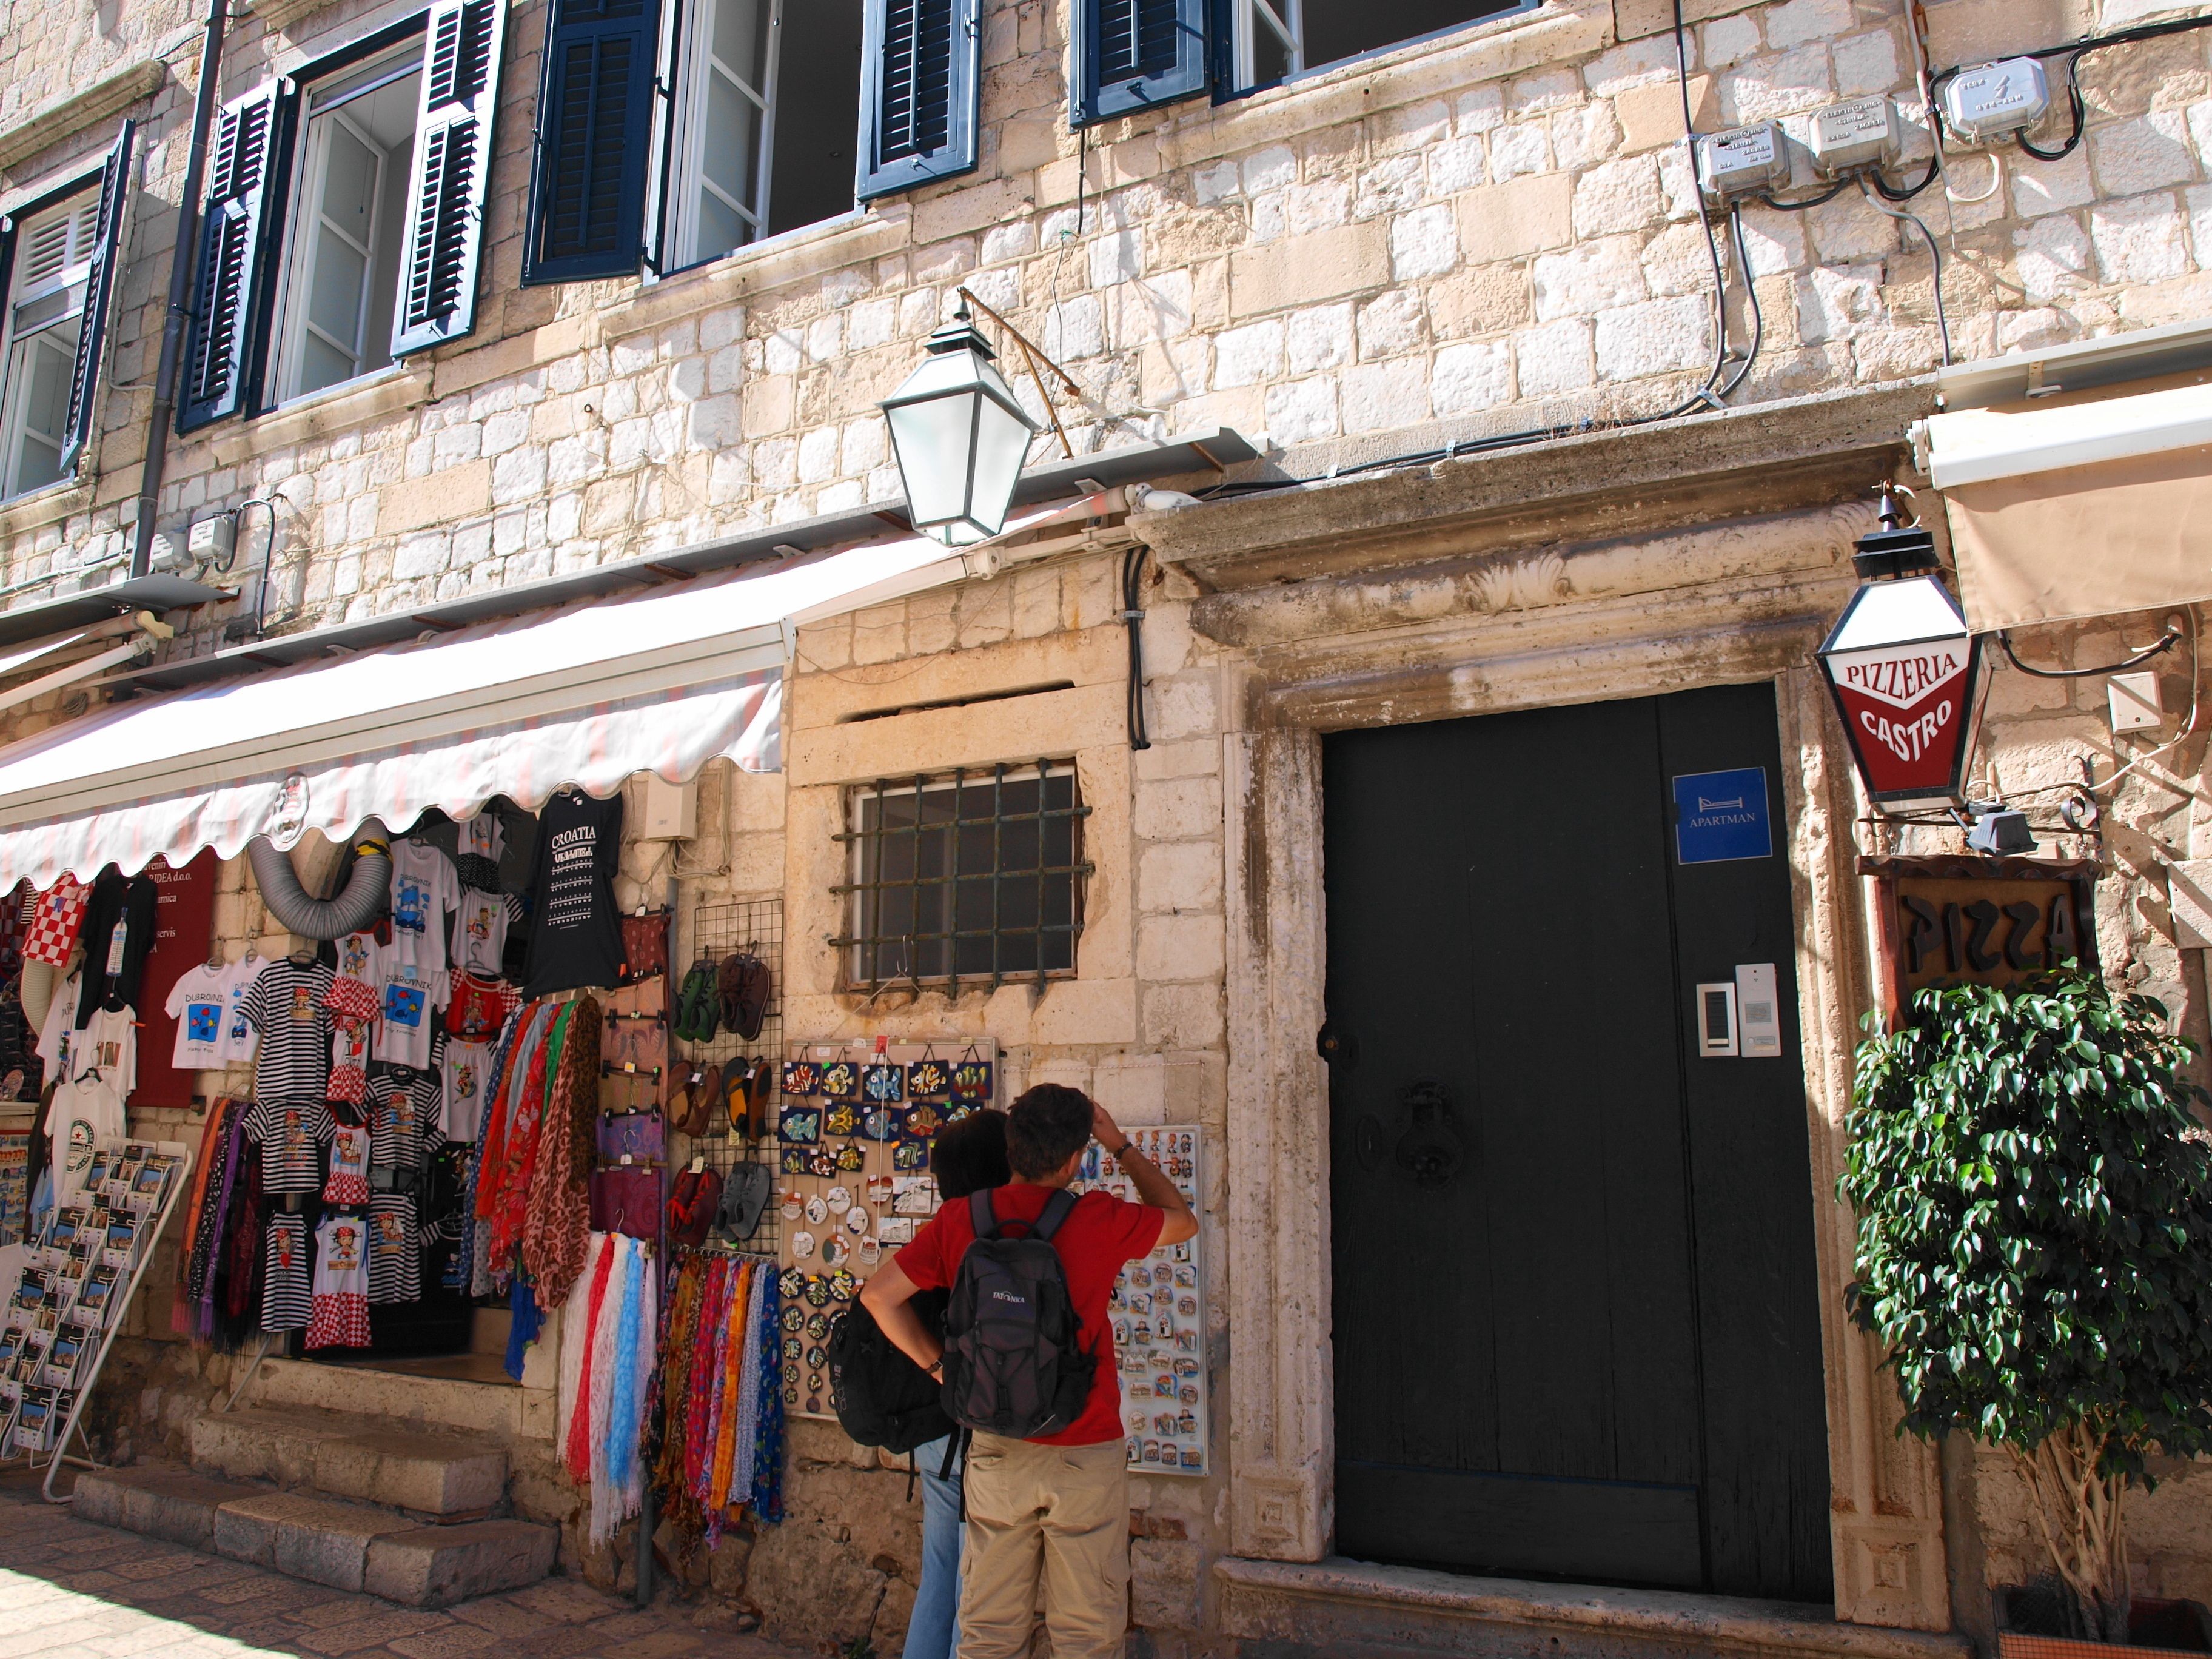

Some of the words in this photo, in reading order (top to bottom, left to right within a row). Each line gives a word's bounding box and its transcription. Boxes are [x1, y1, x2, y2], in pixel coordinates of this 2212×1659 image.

[1846, 652, 1958, 701] PIZZERIA
[1860, 700, 1952, 762] CASTRO
[1689, 813, 1755, 828] APARTMAN
[552, 826, 597, 849] CROATIA
[173, 871, 192, 882] d.o.o.
[156, 927, 176, 938] servis
[1902, 894, 2079, 973] PIZZA
[386, 974, 432, 990] DUBROVNIK
[993, 1291, 1025, 1304] TATONKA
